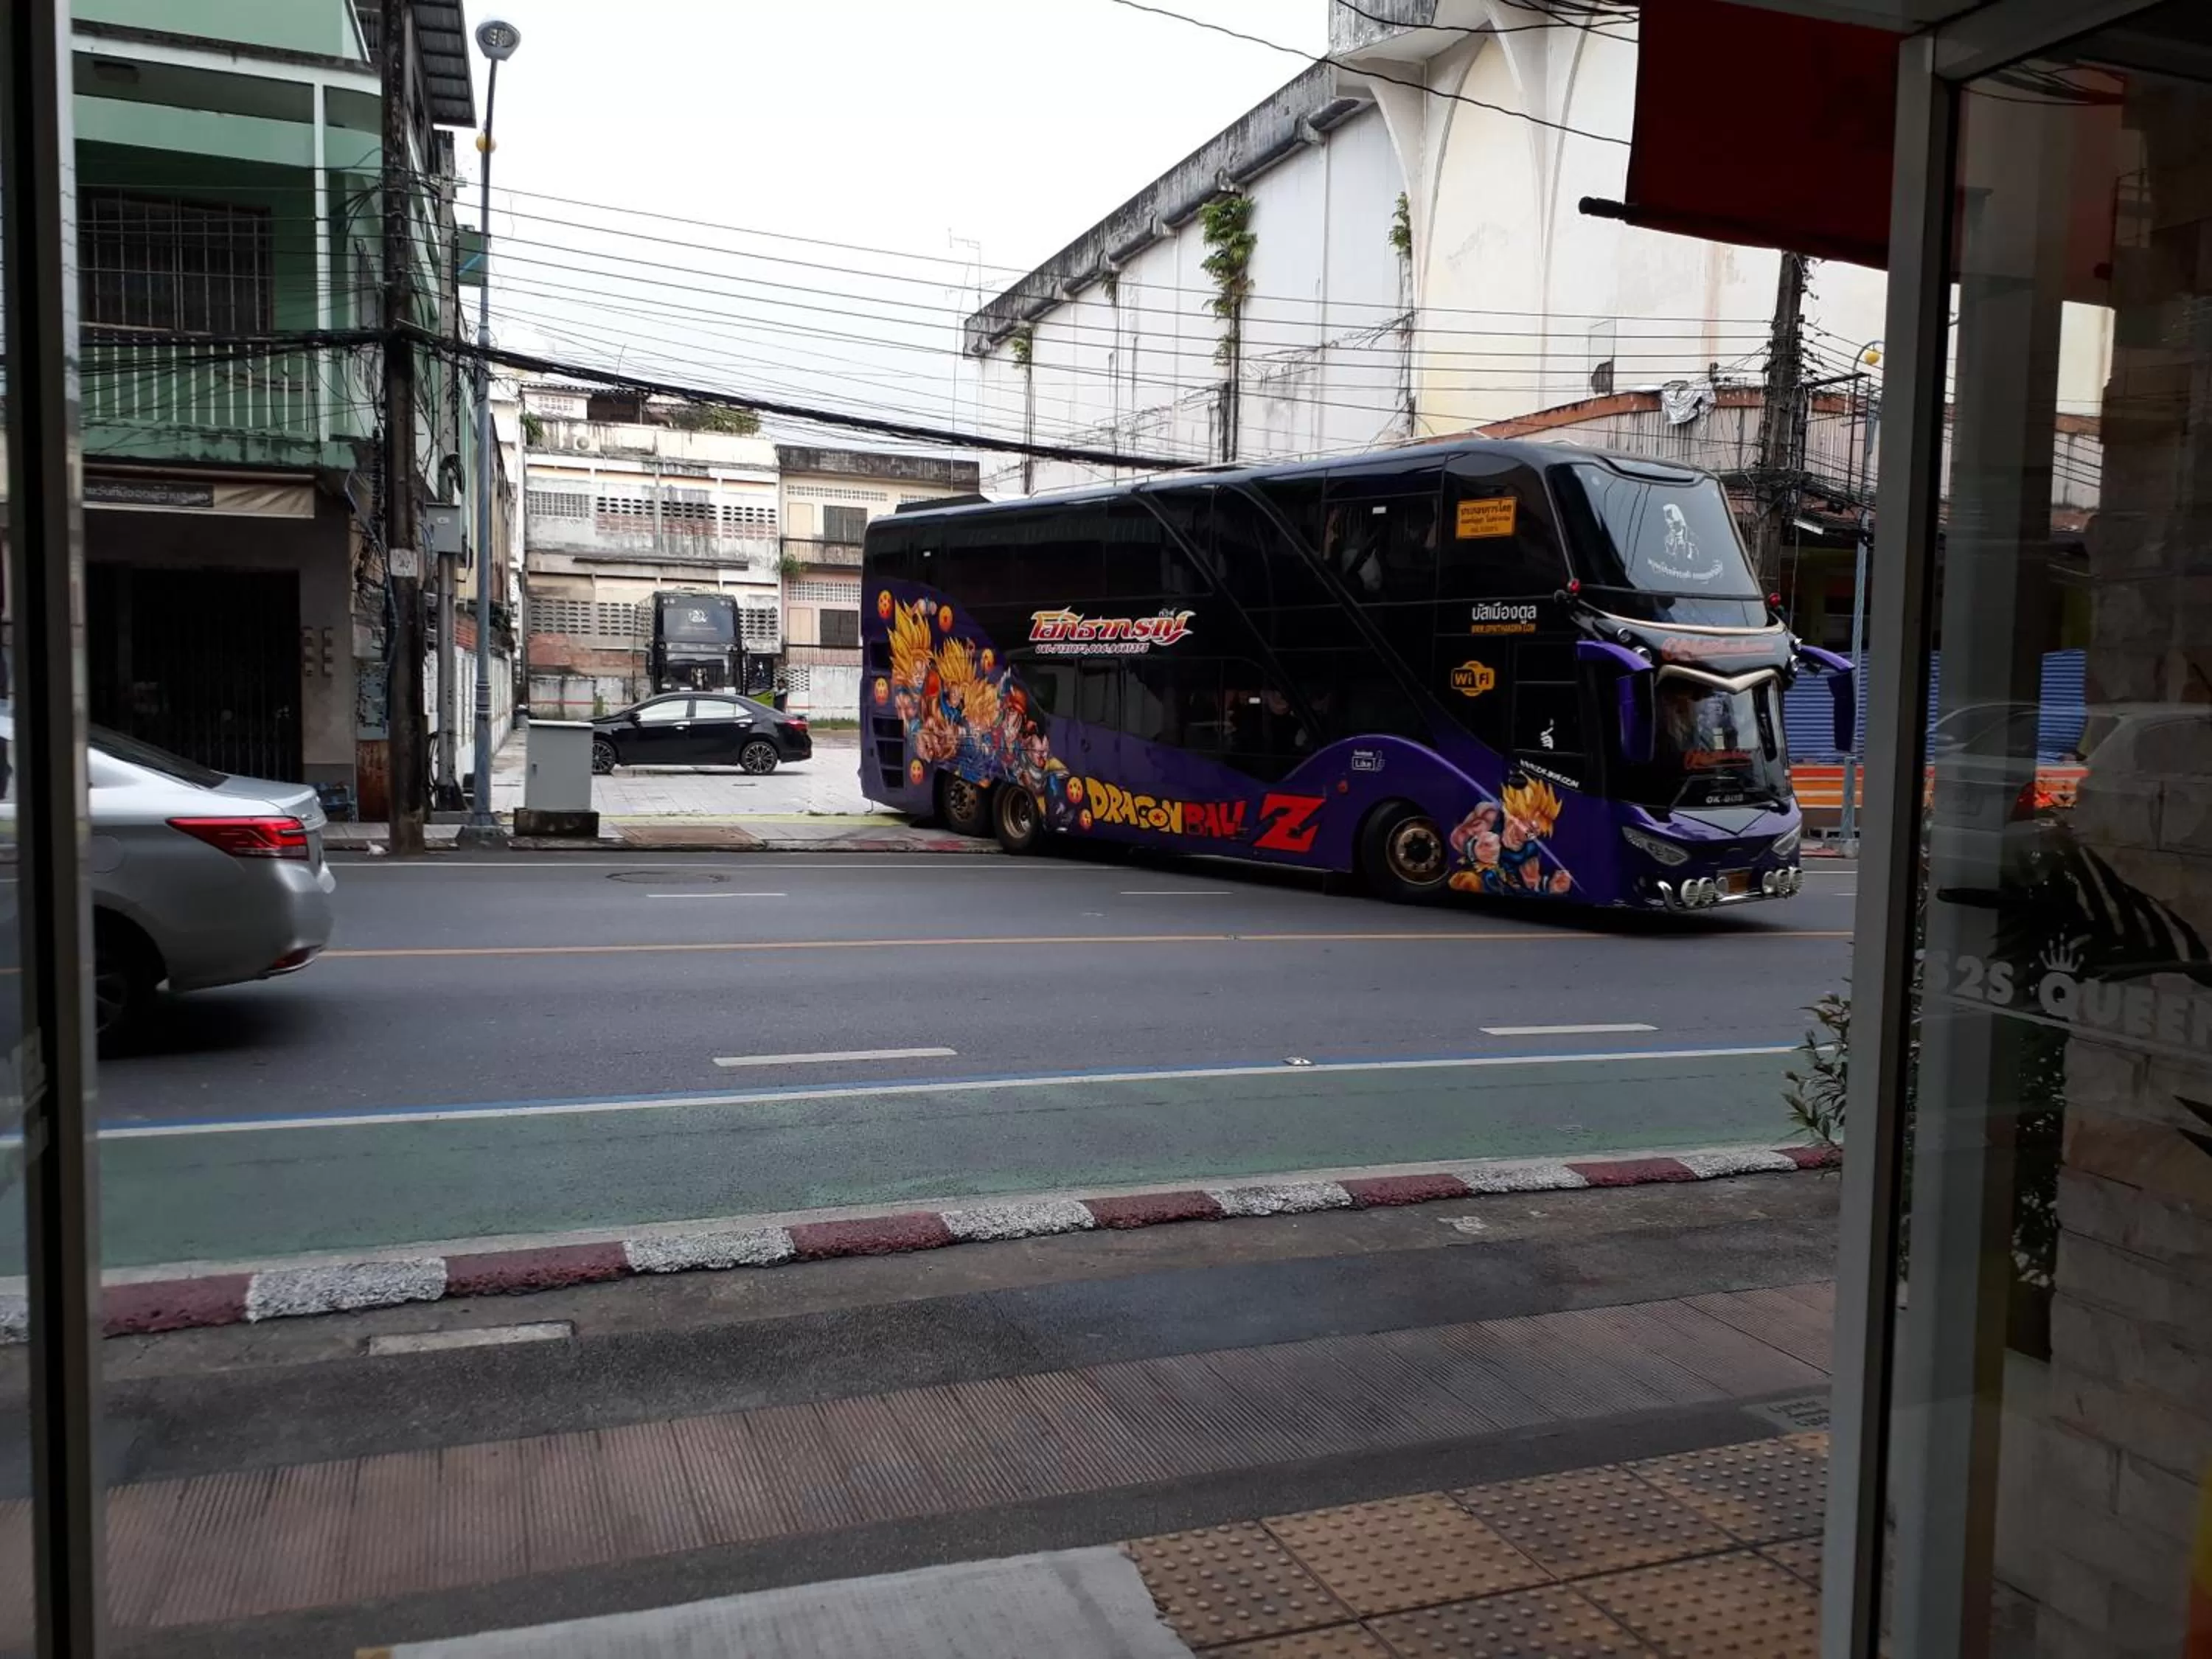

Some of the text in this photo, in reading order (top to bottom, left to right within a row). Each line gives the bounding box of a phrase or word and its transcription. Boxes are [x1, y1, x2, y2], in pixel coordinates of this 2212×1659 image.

[1085, 776, 1326, 852] DRAGON BALL Z
